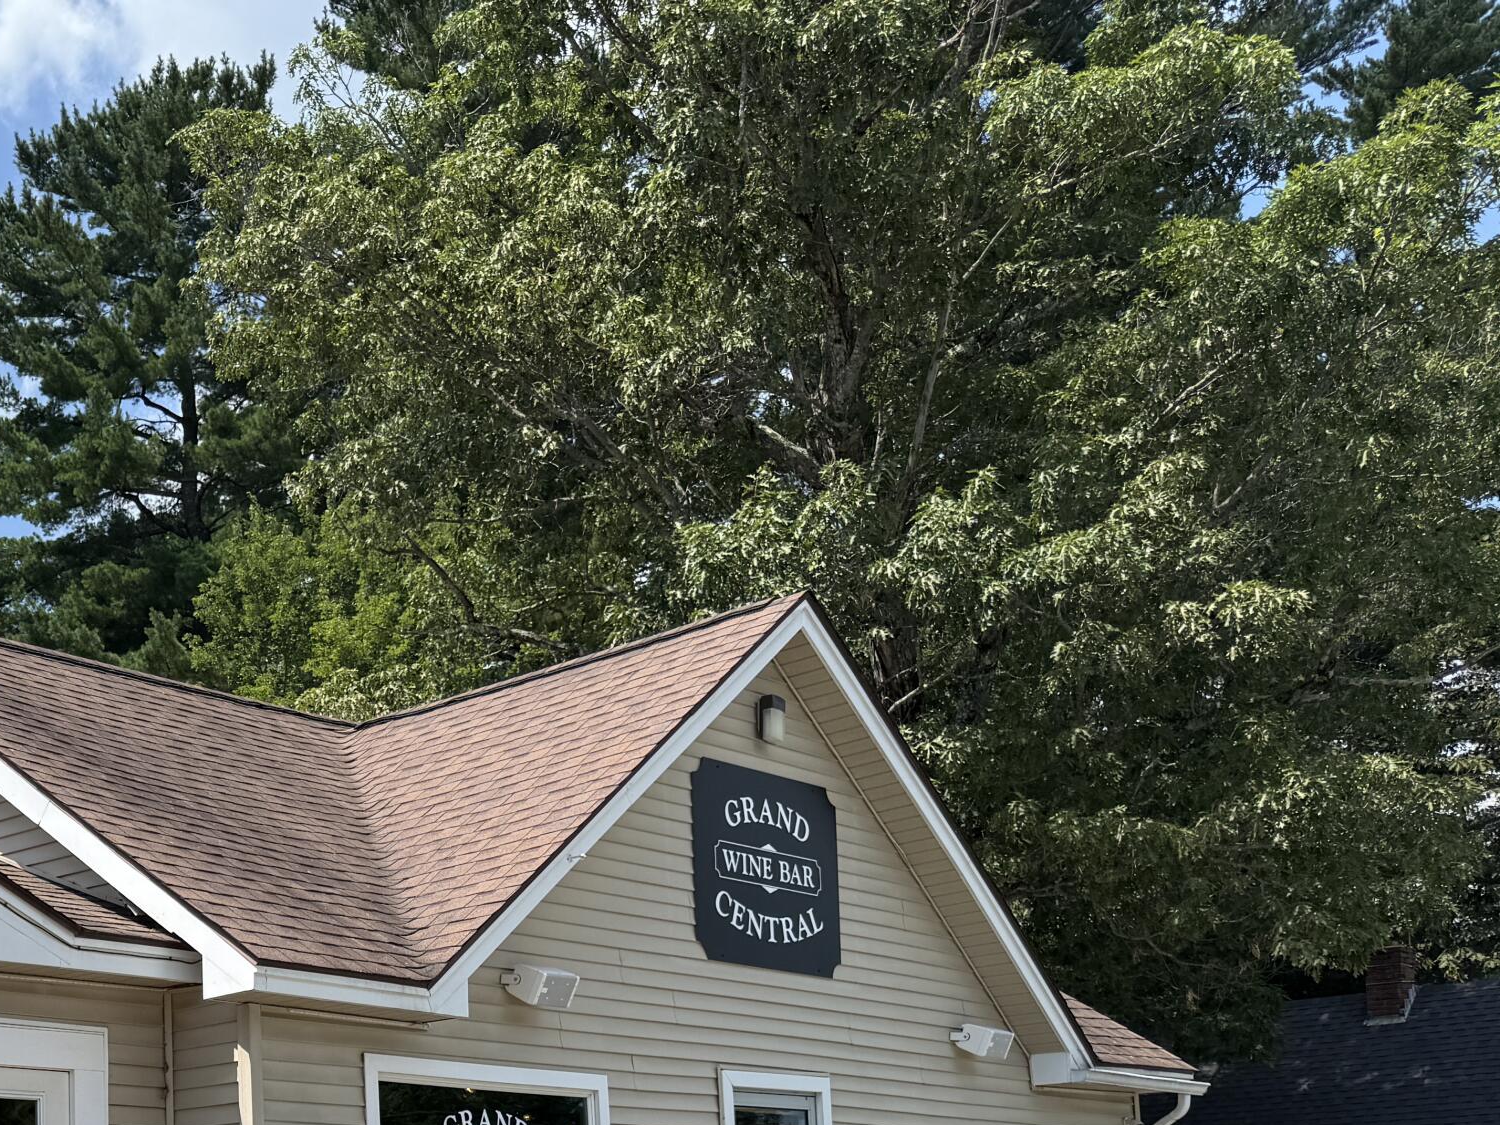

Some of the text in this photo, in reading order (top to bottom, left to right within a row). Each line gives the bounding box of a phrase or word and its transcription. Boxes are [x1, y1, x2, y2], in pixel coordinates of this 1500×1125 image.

[724, 796, 810, 842] GRAND
[722, 848, 815, 889] WINE BAR
[715, 890, 824, 944] CENTRAL
